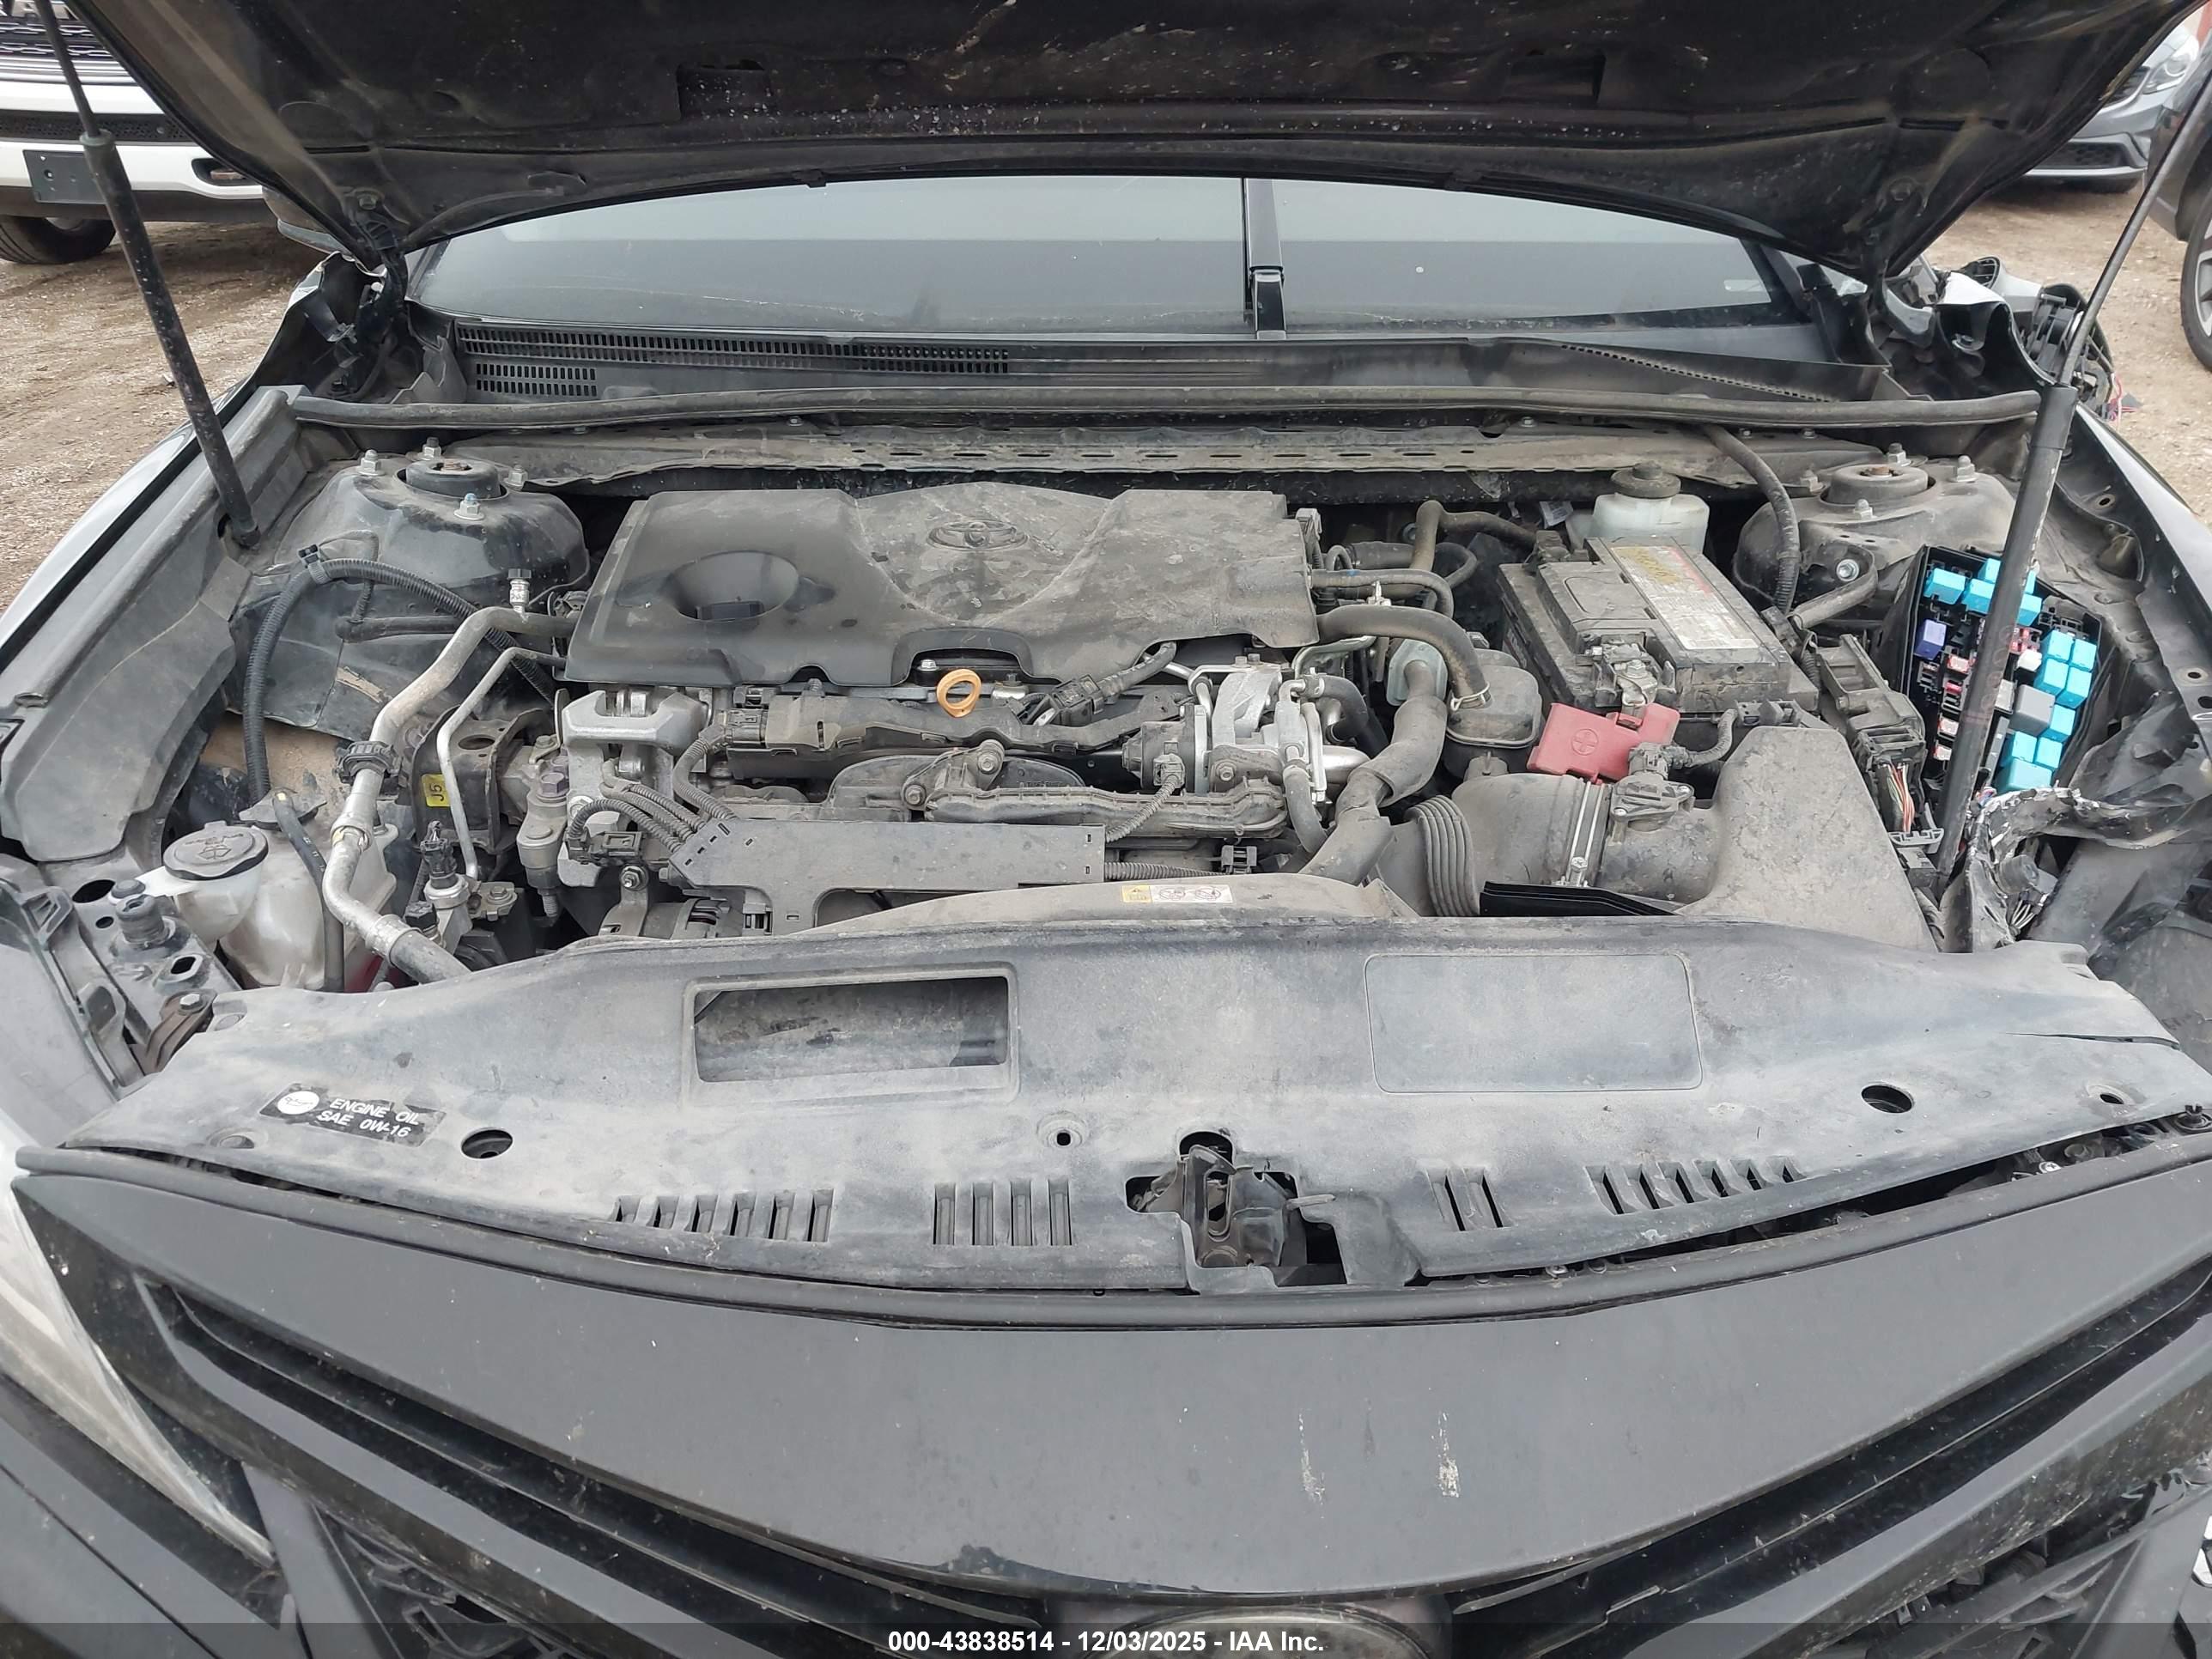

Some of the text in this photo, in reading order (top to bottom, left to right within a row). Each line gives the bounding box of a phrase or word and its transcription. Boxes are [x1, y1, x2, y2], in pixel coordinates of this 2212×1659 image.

[317, 1111, 410, 1138] SAE 0W-16
[330, 1099, 391, 1118] ENGINE
[395, 1110, 421, 1126] OIL
